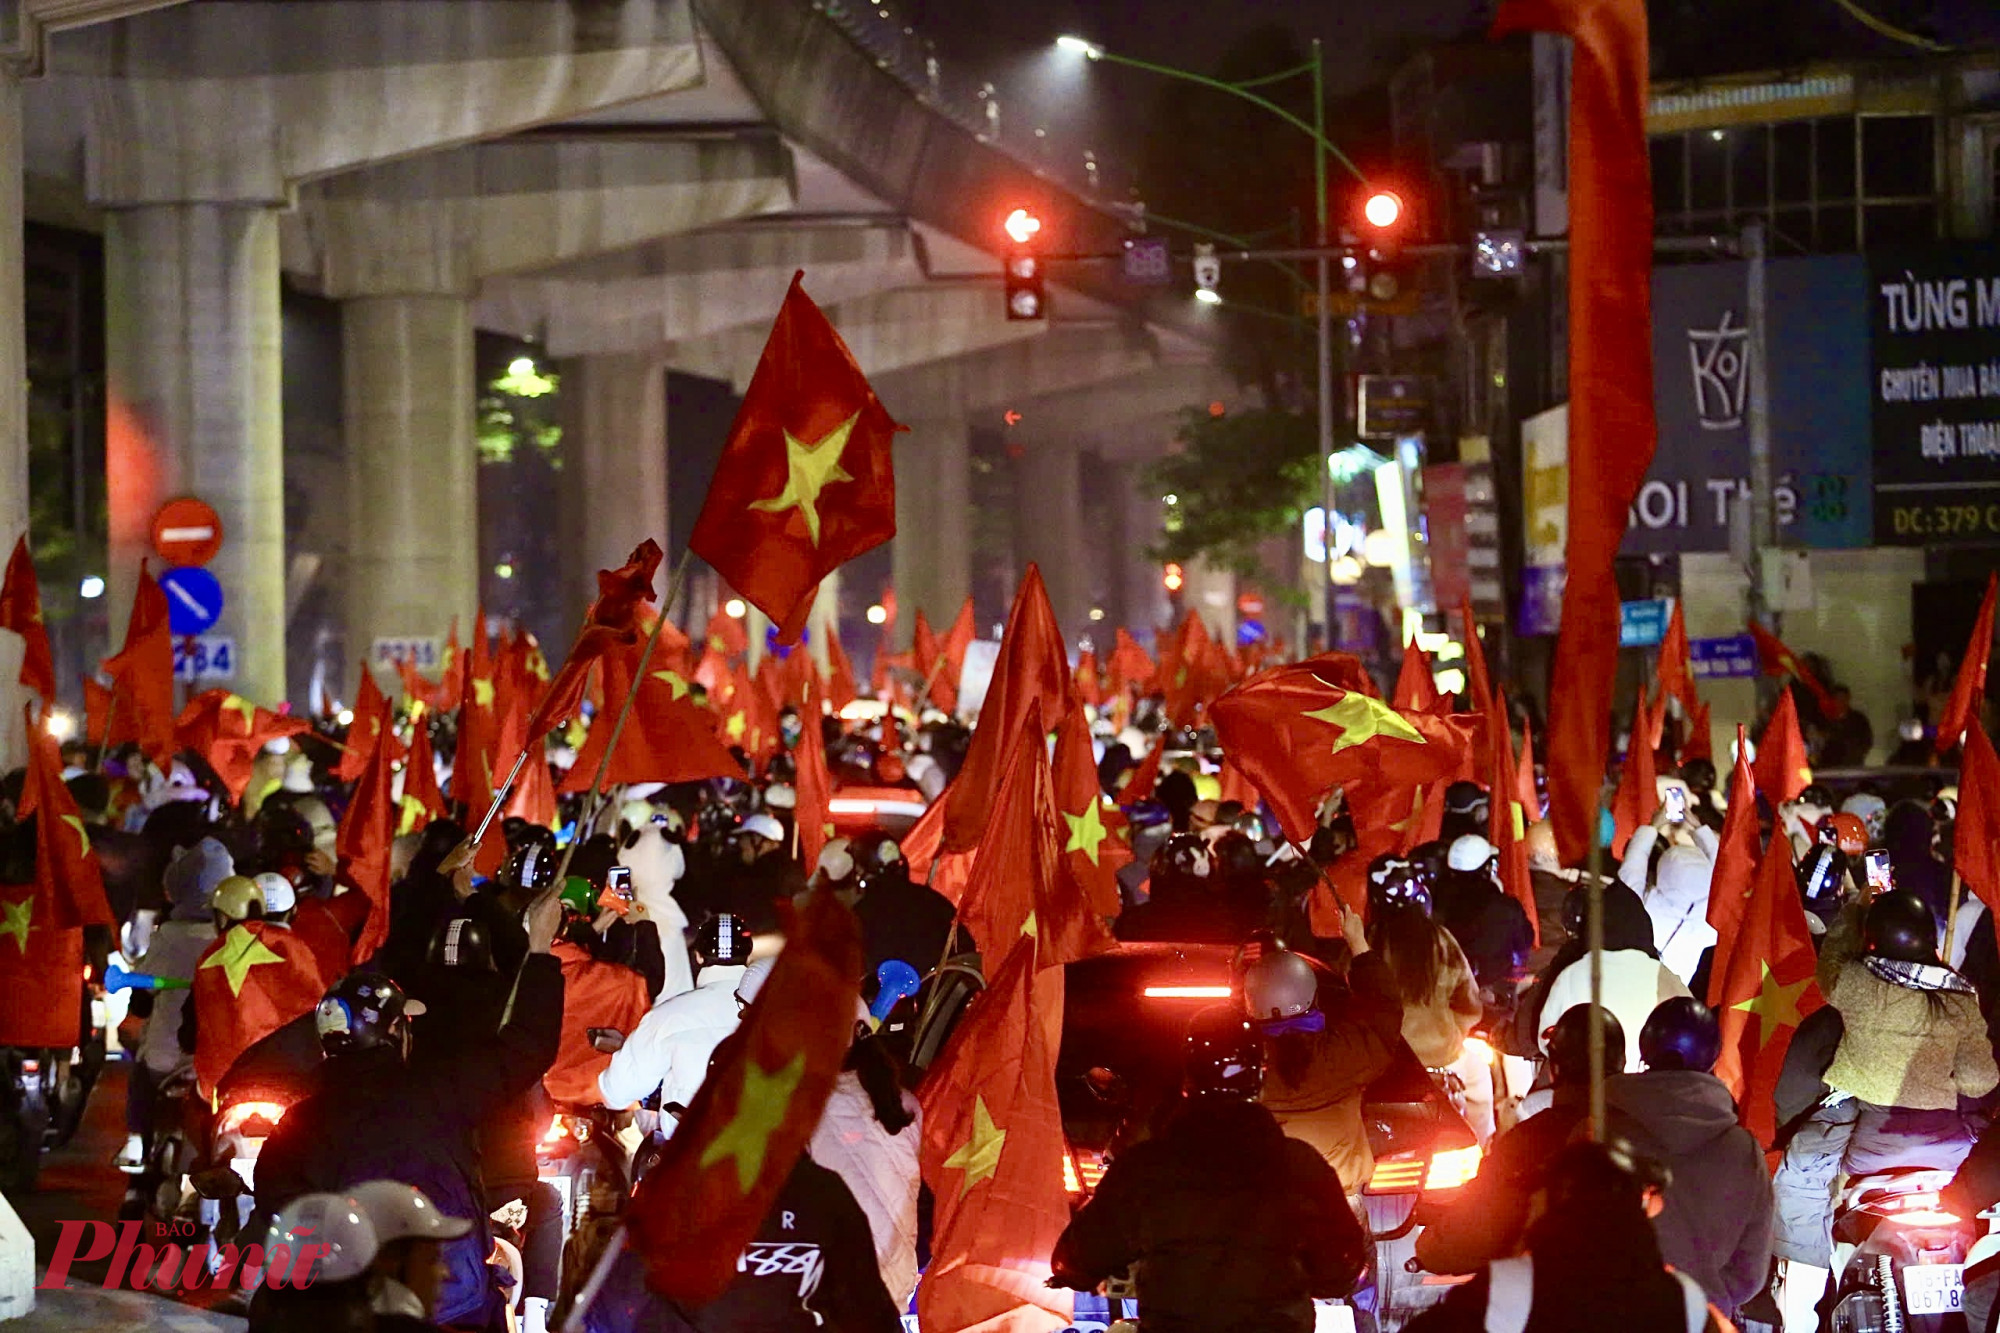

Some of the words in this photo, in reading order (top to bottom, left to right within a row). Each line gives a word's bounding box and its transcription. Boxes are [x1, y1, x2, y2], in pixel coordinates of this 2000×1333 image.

[1880, 269, 1969, 332] TÙNG
[1629, 481, 1689, 528] OI
[782, 1210, 795, 1230] R
